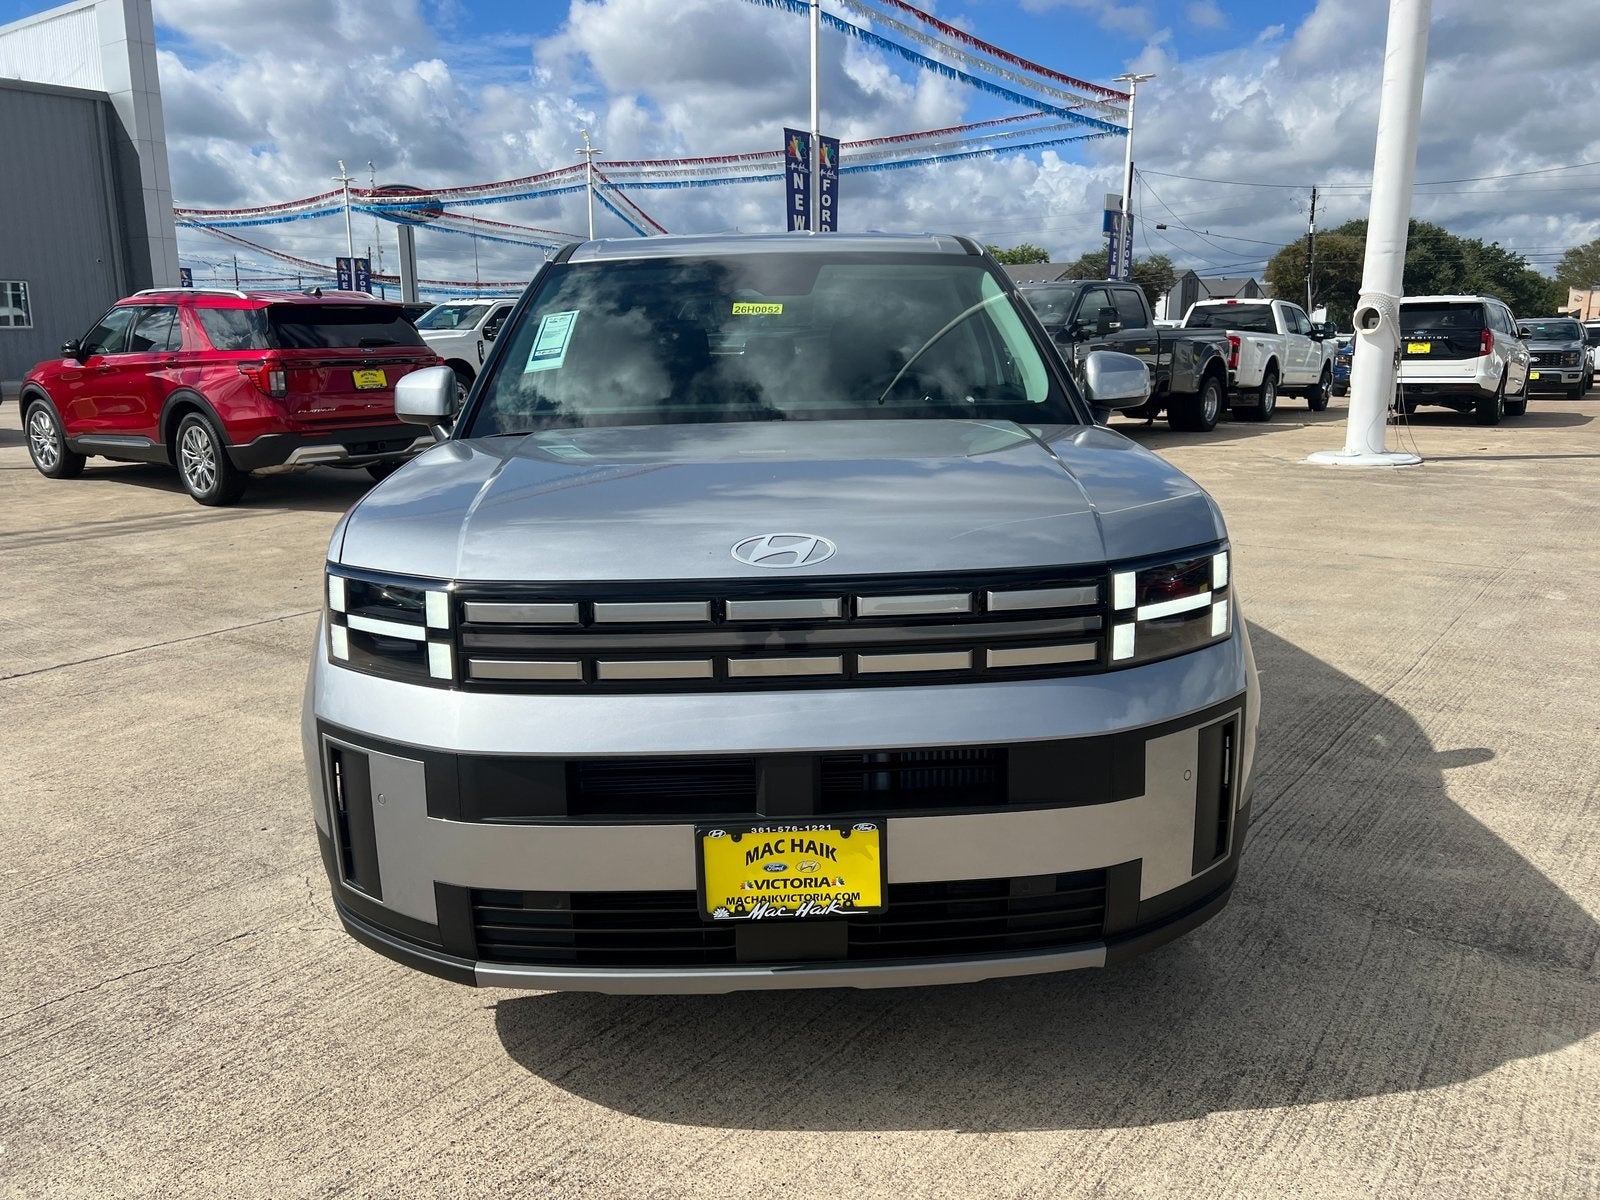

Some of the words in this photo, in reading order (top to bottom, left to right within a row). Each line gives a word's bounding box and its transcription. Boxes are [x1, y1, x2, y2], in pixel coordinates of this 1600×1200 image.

[793, 173, 805, 231] NEW
[341, 274, 349, 290] NE
[734, 305, 780, 314] 26H0052
[750, 823, 832, 834] 361-576-1221
[745, 838, 786, 867] MAC
[790, 837, 838, 863] HAIK
[753, 877, 832, 890] VICTORIA
[749, 901, 787, 920] Mac
[794, 899, 846, 918] Haik
